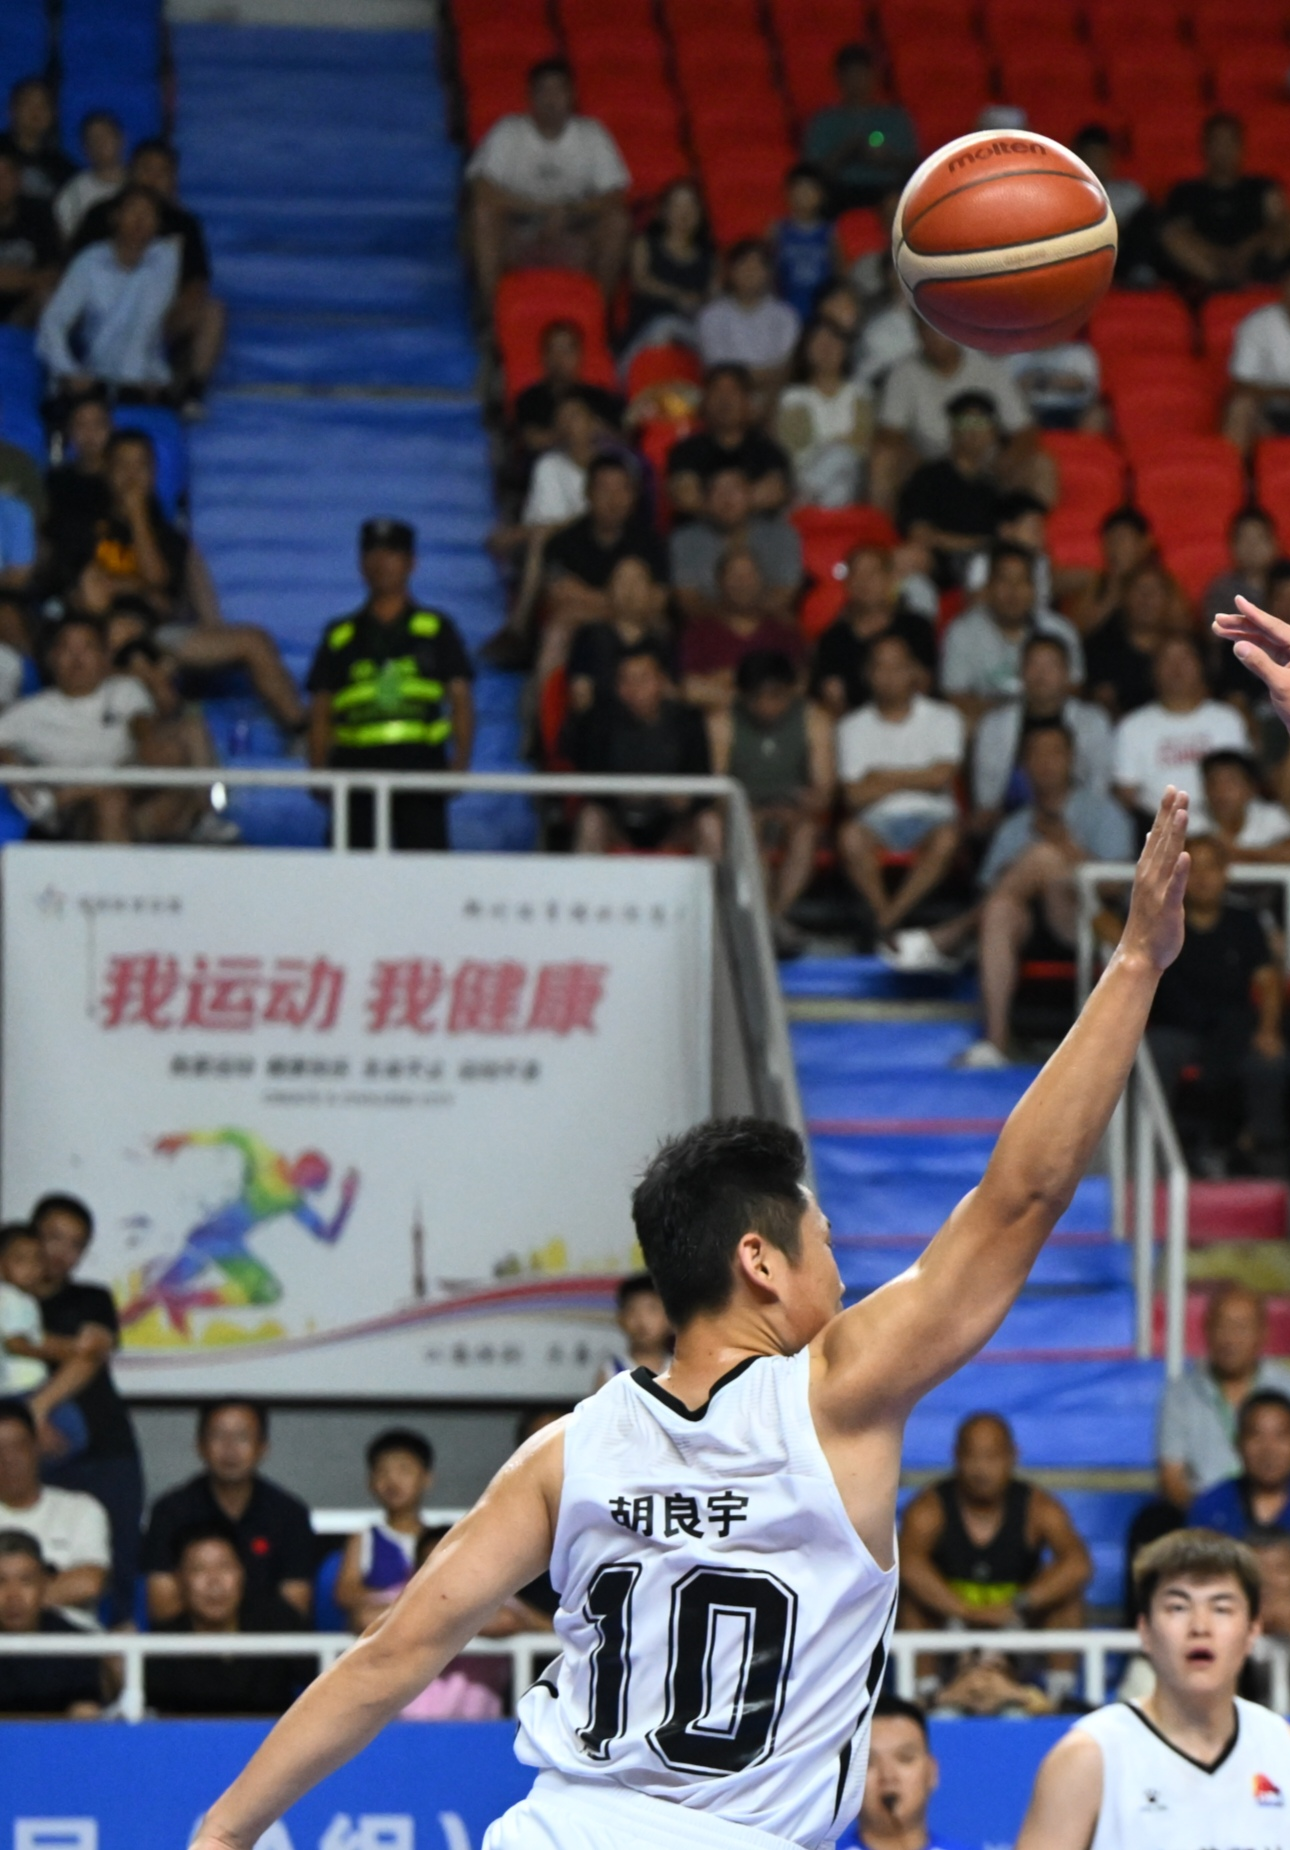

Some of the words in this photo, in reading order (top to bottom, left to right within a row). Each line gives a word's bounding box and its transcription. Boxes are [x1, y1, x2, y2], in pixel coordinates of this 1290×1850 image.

[947, 140, 1047, 174] molten
[101, 950, 345, 1033] 我运动
[366, 956, 609, 1037] 我健康
[608, 1490, 749, 1539] 胡良宇
[575, 1561, 798, 1778] 10
